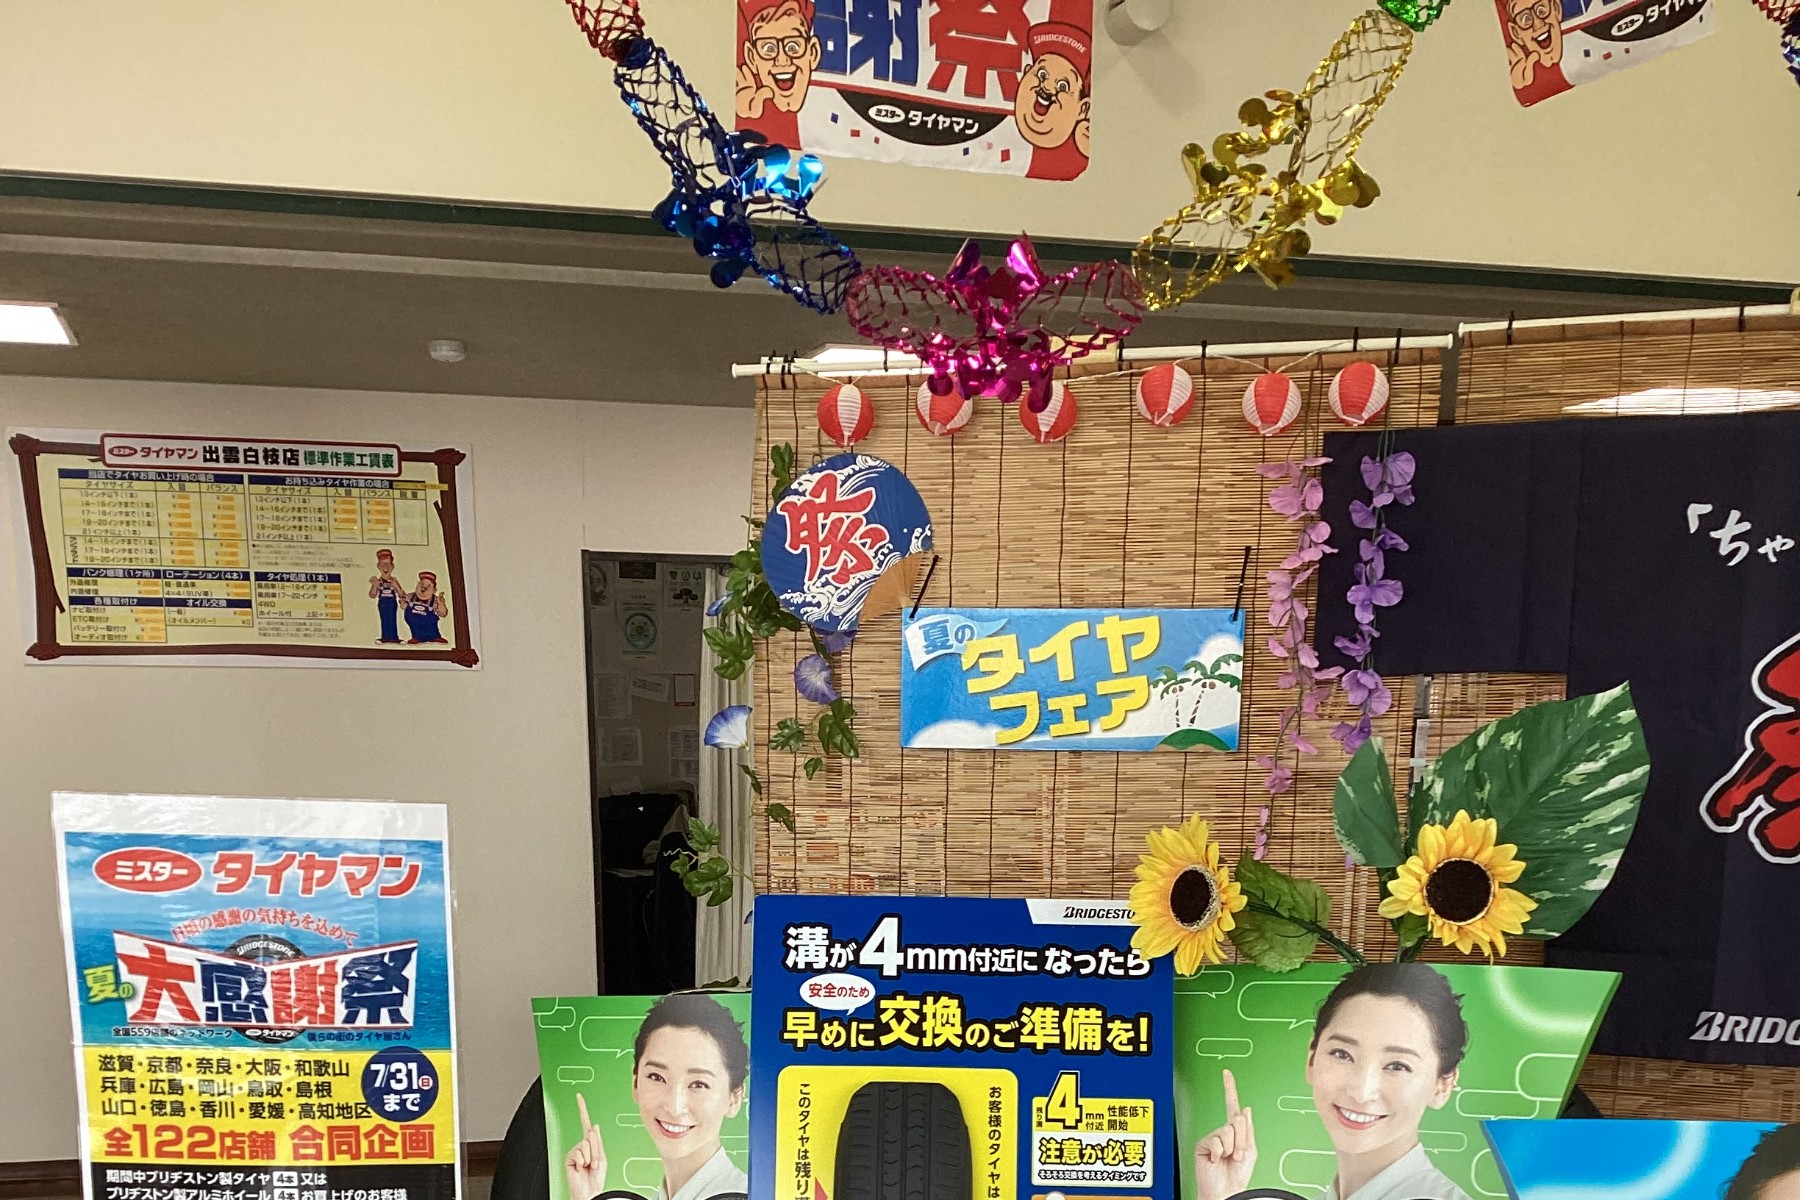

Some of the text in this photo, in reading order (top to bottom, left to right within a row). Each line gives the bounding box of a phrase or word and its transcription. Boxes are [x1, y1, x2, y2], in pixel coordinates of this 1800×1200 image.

[875, 108, 979, 136] ミスター タイヤマン
[140, 445, 394, 469] タイヤマン 出雲白枝店 標準作業工賃表
[922, 620, 976, 656] 夏の
[962, 615, 1162, 695] タイヤ
[989, 675, 1150, 745] フェア
[114, 851, 421, 898] ミスター タイヤマン
[171, 907, 360, 948] 日頃の感謝の気持ちを込めて
[236, 940, 297, 957] BRIDGESTONE
[785, 916, 1151, 977] 溝が4mm付近に なったら
[83, 964, 135, 1002] 夏の
[115, 942, 418, 1025] 大感謝祭
[808, 982, 870, 999] 安全のため
[783, 995, 1149, 1052] 早めに交換のご準備を!
[98, 1054, 350, 1078] 滋賀・京都・奈良・大阪・和歌山
[370, 1061, 419, 1091] 7/31
[100, 1076, 333, 1099] 兵庫・広島・岡山・鳥取・島根
[1044, 1069, 1150, 1131] 4 mm 性能低下
[101, 1099, 373, 1121] 山口・徳島・香川・愛媛・高知地区
[384, 1093, 421, 1113] まで
[1036, 1105, 1044, 1129] 残り溝
[1085, 1119, 1129, 1132] 付近 開始
[104, 1123, 436, 1161] 全122店舗 合同企画
[1038, 1137, 1147, 1167] 注意が必要
[276, 1173, 295, 1186] 4本
[301, 1172, 327, 1186] 又は
[1038, 1169, 1147, 1182] そろそろ交換を考えるタイミングです
